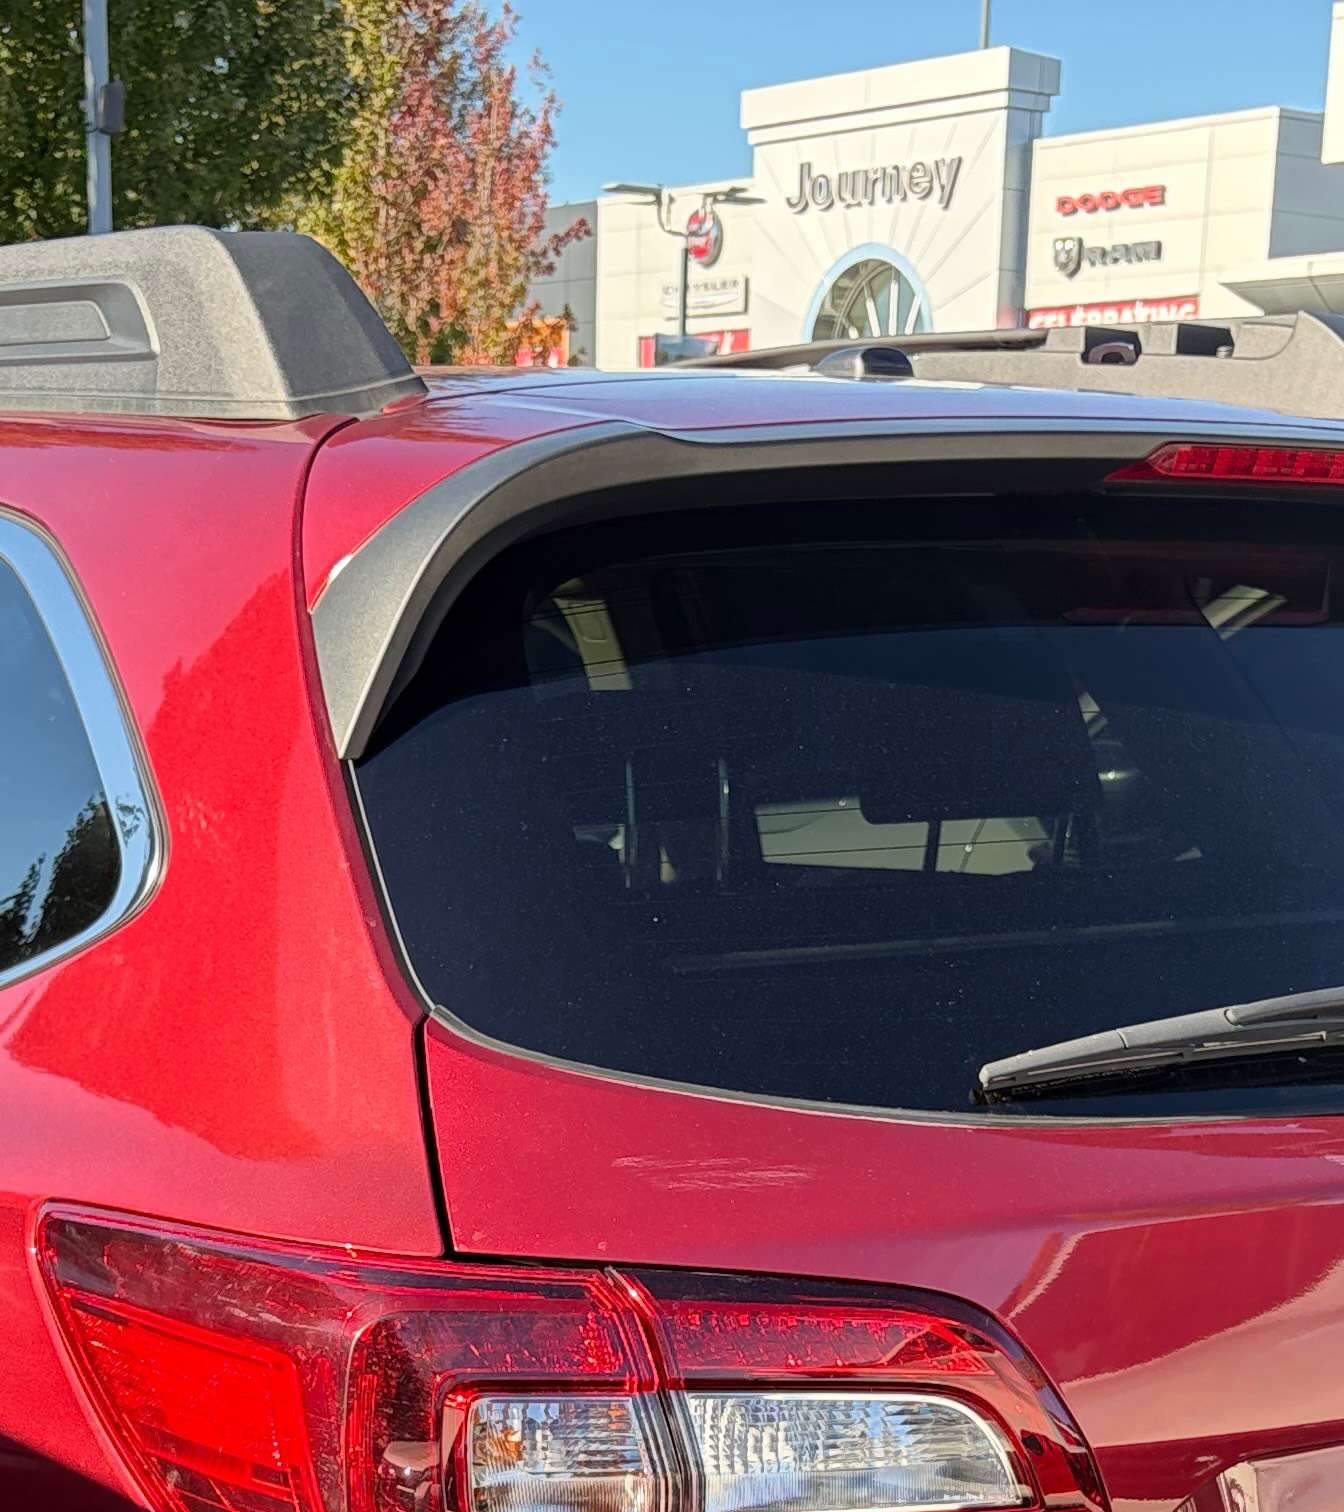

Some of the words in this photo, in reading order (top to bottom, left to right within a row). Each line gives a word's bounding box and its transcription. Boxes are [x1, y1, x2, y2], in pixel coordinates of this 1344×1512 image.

[786, 156, 962, 214] Journey
[1056, 185, 1166, 216] DODGE
[1086, 241, 1162, 267] RAM
